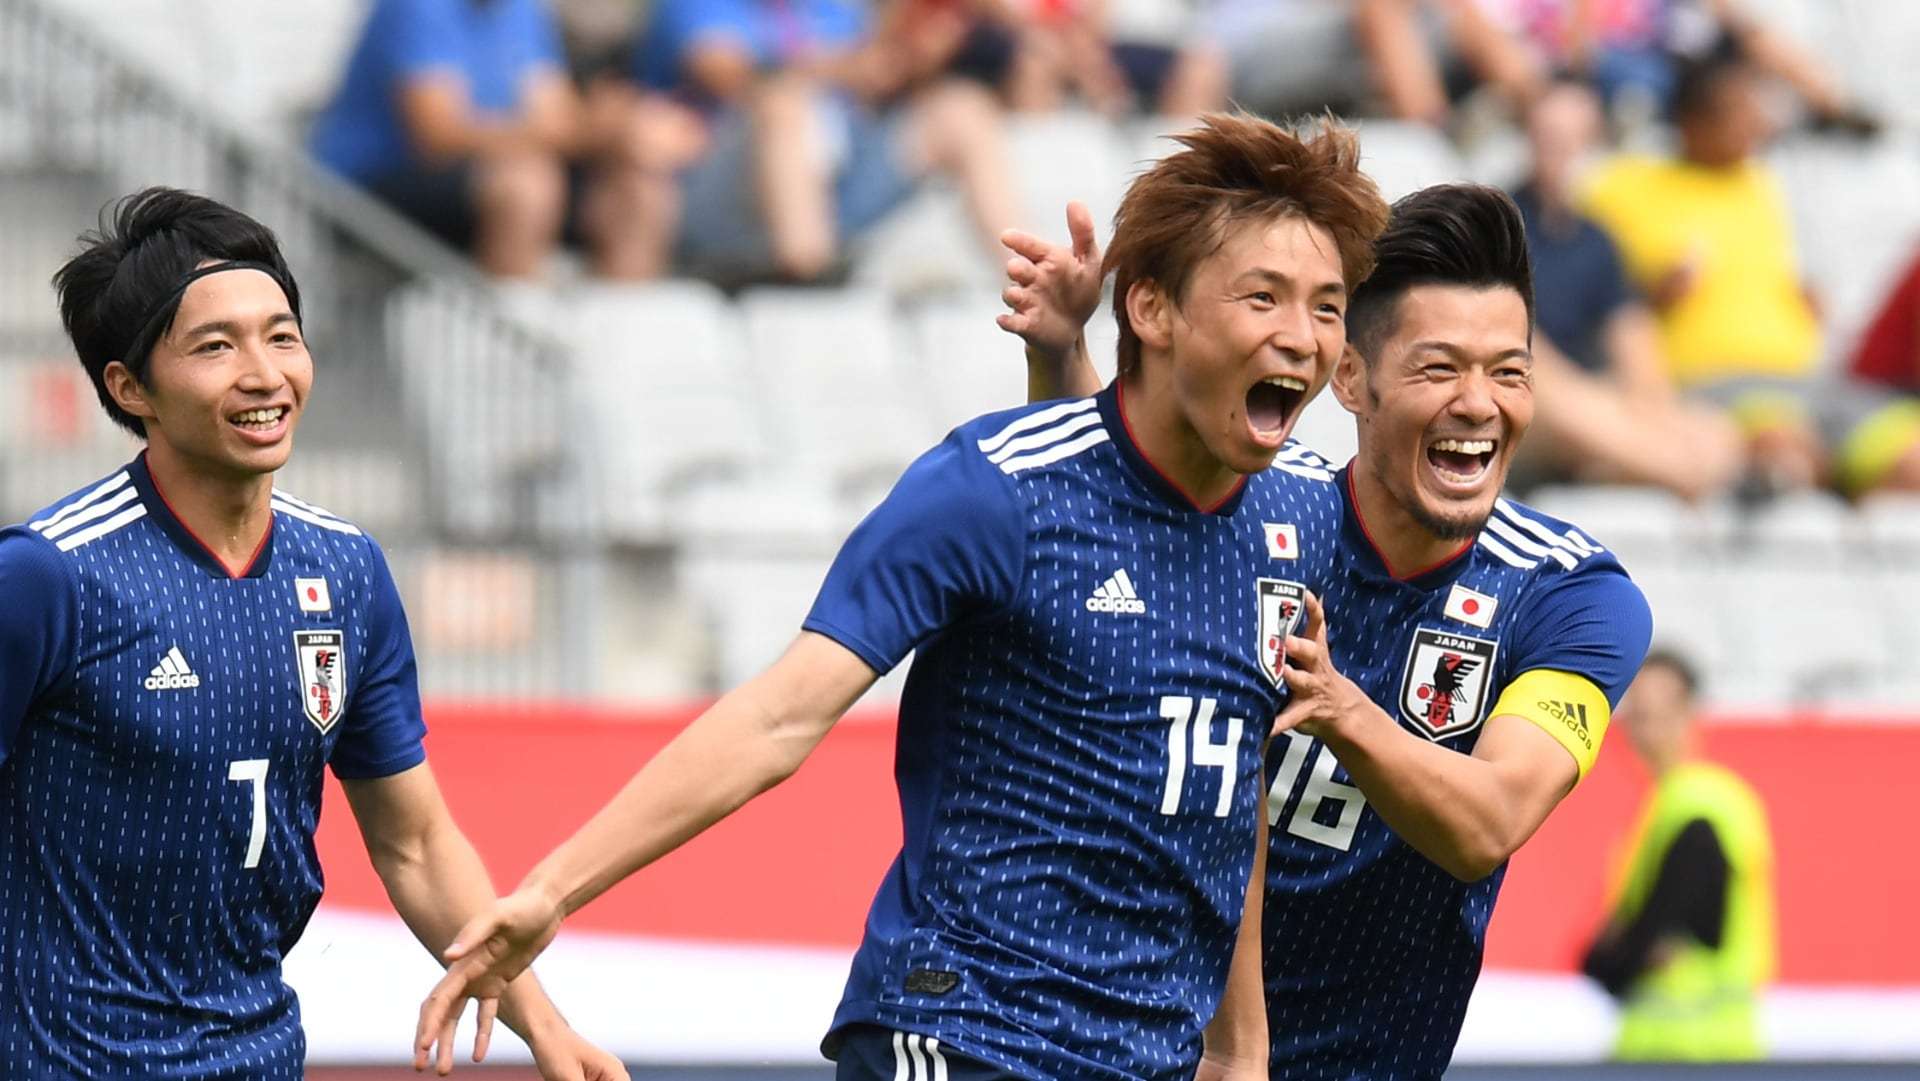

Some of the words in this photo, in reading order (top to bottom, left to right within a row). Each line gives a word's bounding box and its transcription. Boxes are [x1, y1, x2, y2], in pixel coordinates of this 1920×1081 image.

[1272, 584, 1298, 596] JAPAN
[1085, 596, 1146, 614] adidas
[308, 635, 333, 644] JAPAN
[1434, 636, 1476, 651] JAPAN
[144, 673, 200, 690] adidas
[1536, 701, 1592, 751] adidas
[1159, 695, 1244, 818] 14
[228, 758, 270, 868] 7
